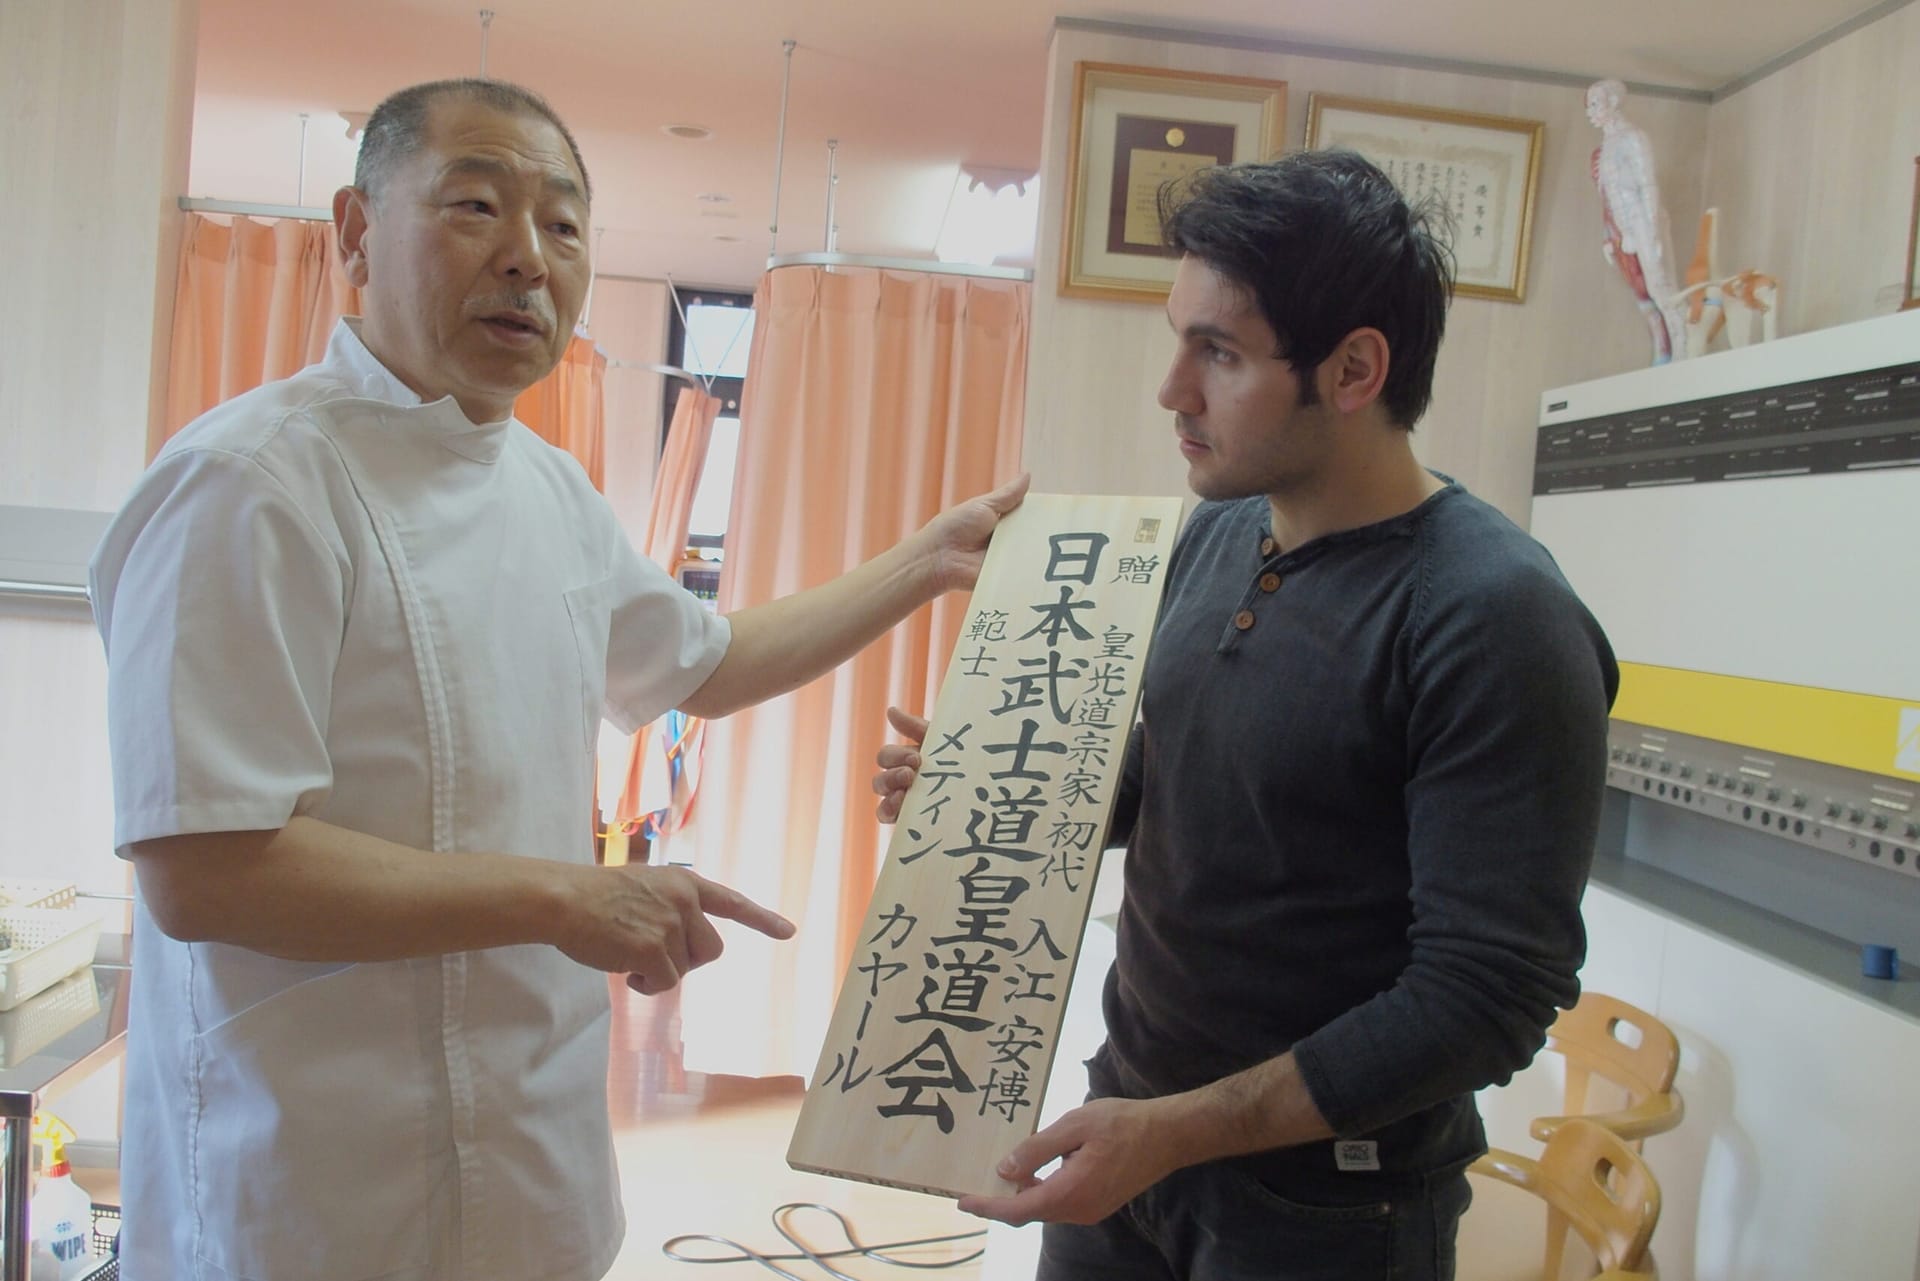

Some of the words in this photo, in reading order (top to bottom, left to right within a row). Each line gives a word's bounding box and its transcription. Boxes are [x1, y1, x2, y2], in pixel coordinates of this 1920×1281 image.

[1112, 554, 1160, 585] 贈
[959, 609, 1008, 678] 範士
[875, 532, 1110, 1135] 日本武士道皇道会
